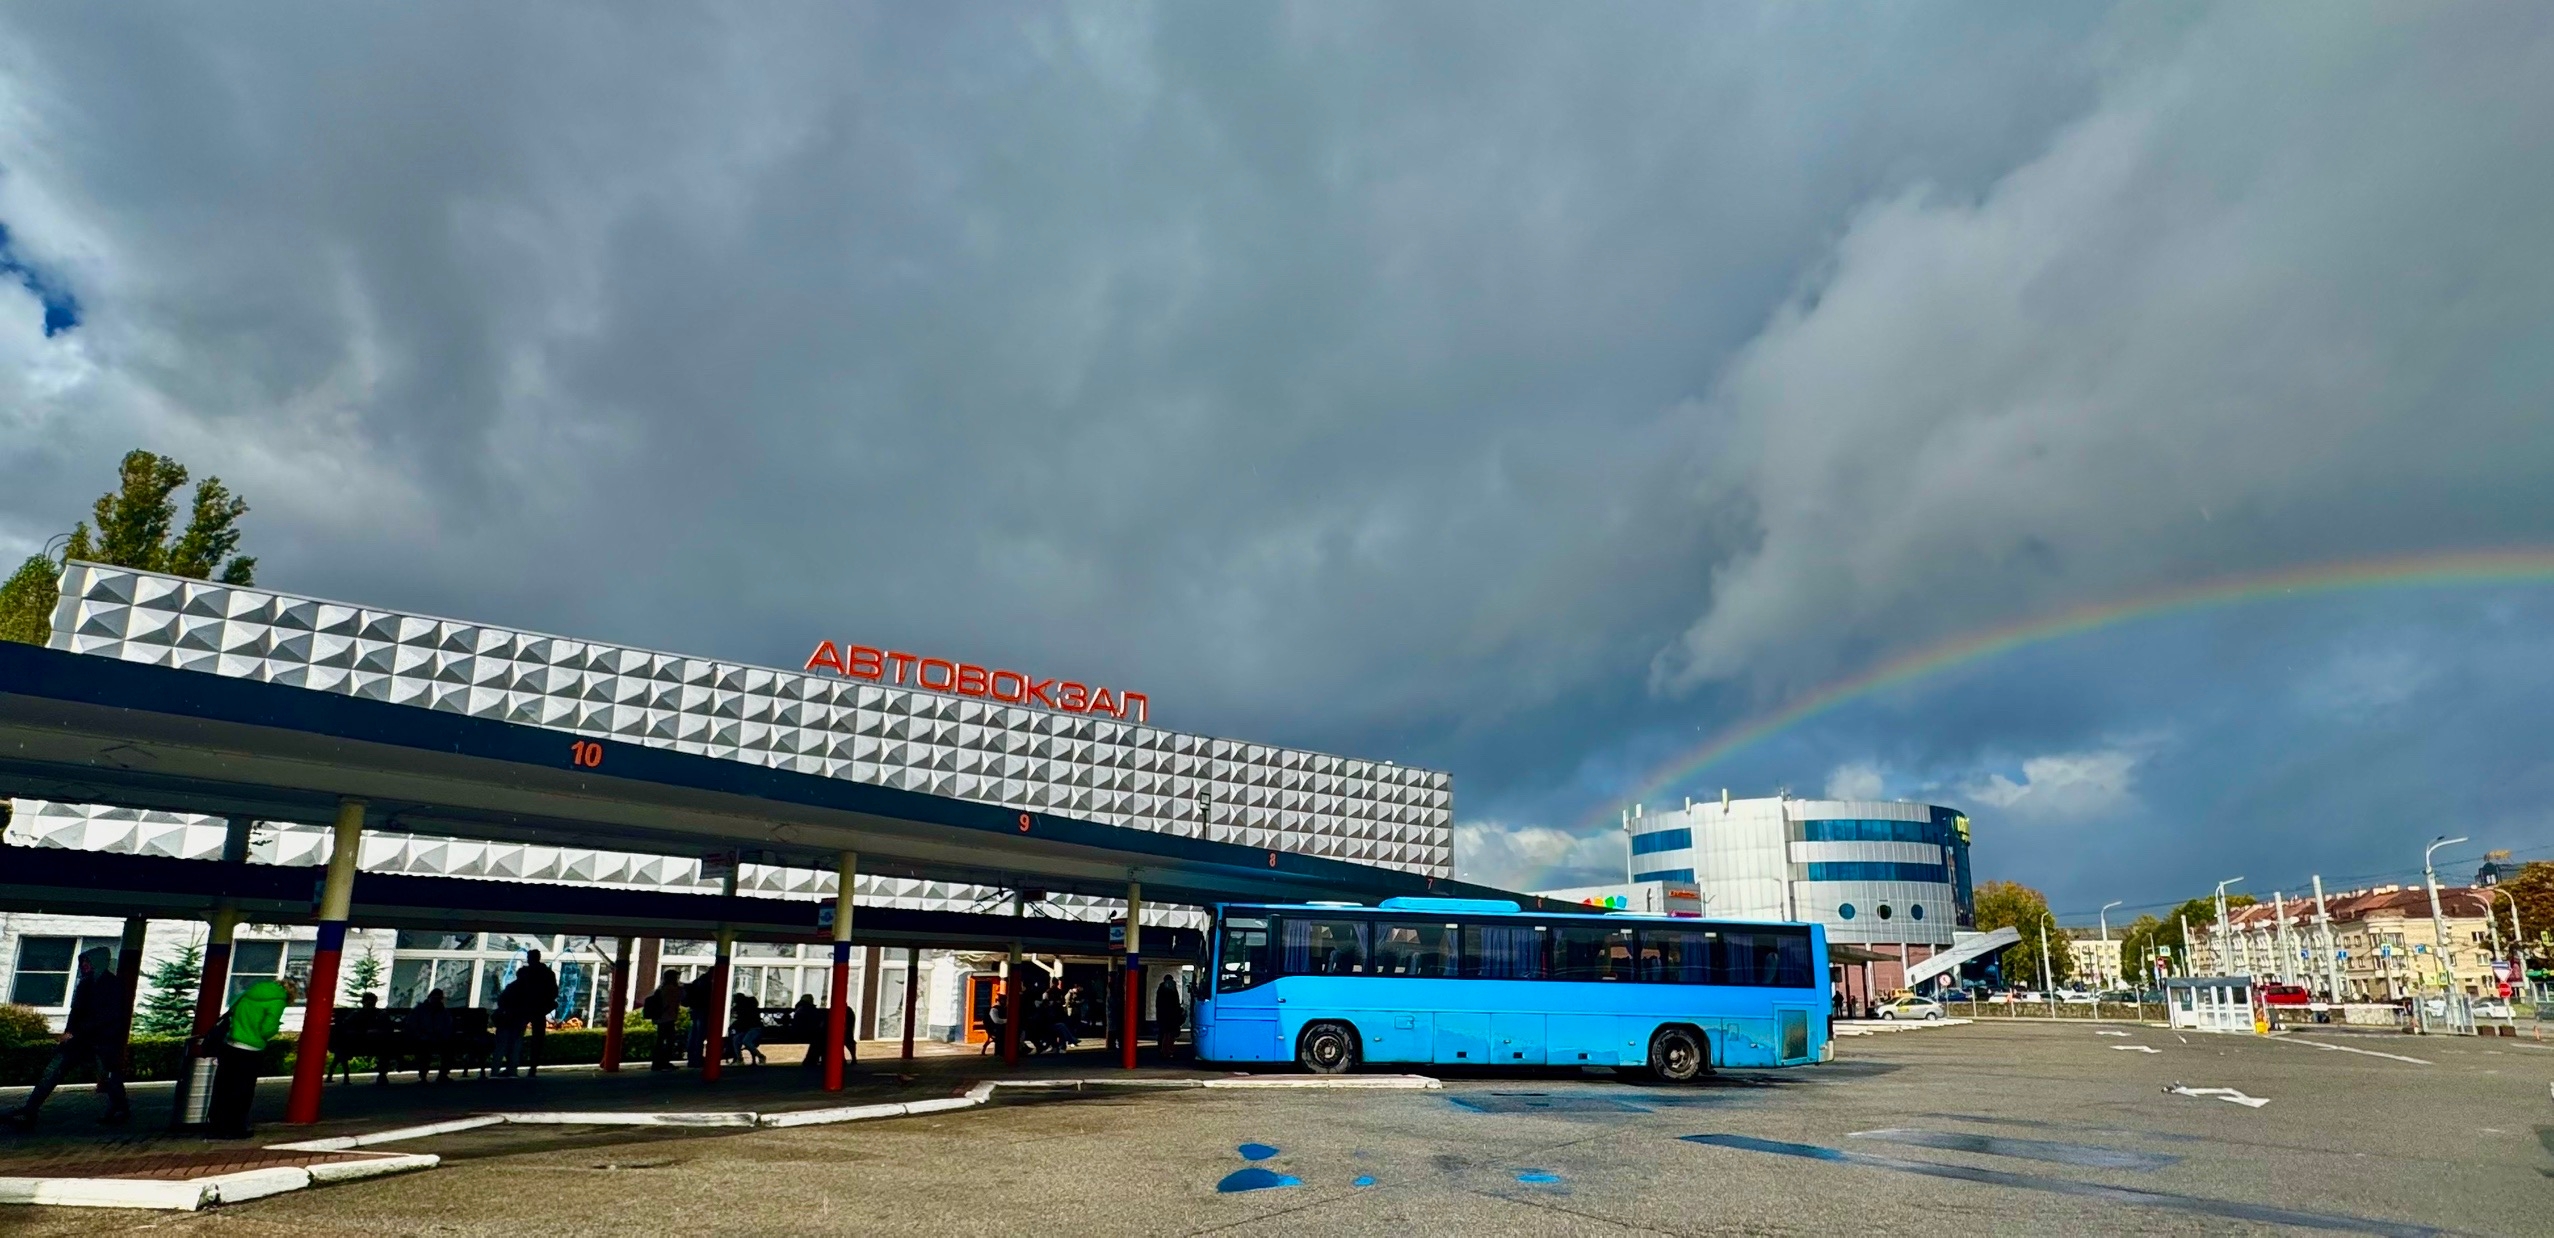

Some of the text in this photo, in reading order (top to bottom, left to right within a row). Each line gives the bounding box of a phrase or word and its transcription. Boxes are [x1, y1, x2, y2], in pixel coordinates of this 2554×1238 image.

[804, 640, 1149, 723] АВТОВОКЗАЛ
[571, 740, 603, 768] 10
[1019, 813, 1030, 832] 9
[1269, 852, 1276, 868] 8
[1427, 878, 1434, 890] 7
